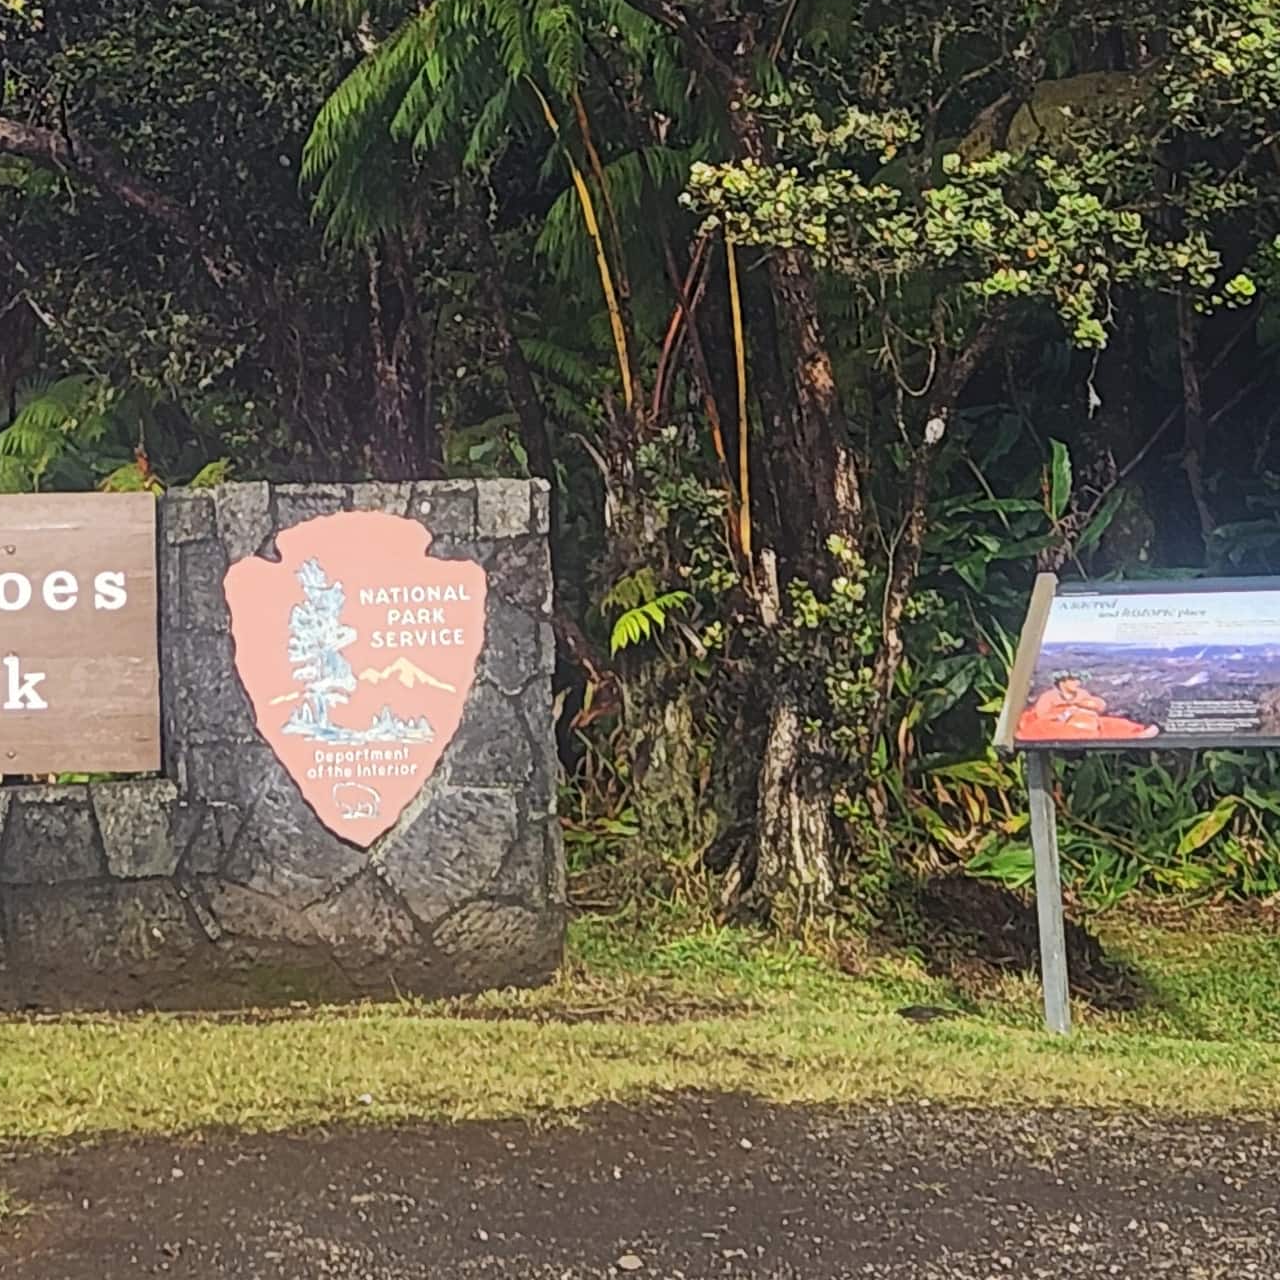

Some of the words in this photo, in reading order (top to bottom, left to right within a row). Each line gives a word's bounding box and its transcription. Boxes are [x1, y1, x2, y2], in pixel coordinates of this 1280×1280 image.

[359, 584, 471, 606] NATIONAL
[386, 608, 445, 625] PARK
[370, 628, 465, 649] SERVICE
[315, 746, 409, 763] Department
[307, 764, 324, 779] of
[327, 764, 352, 778] the
[357, 762, 418, 777] Interior
